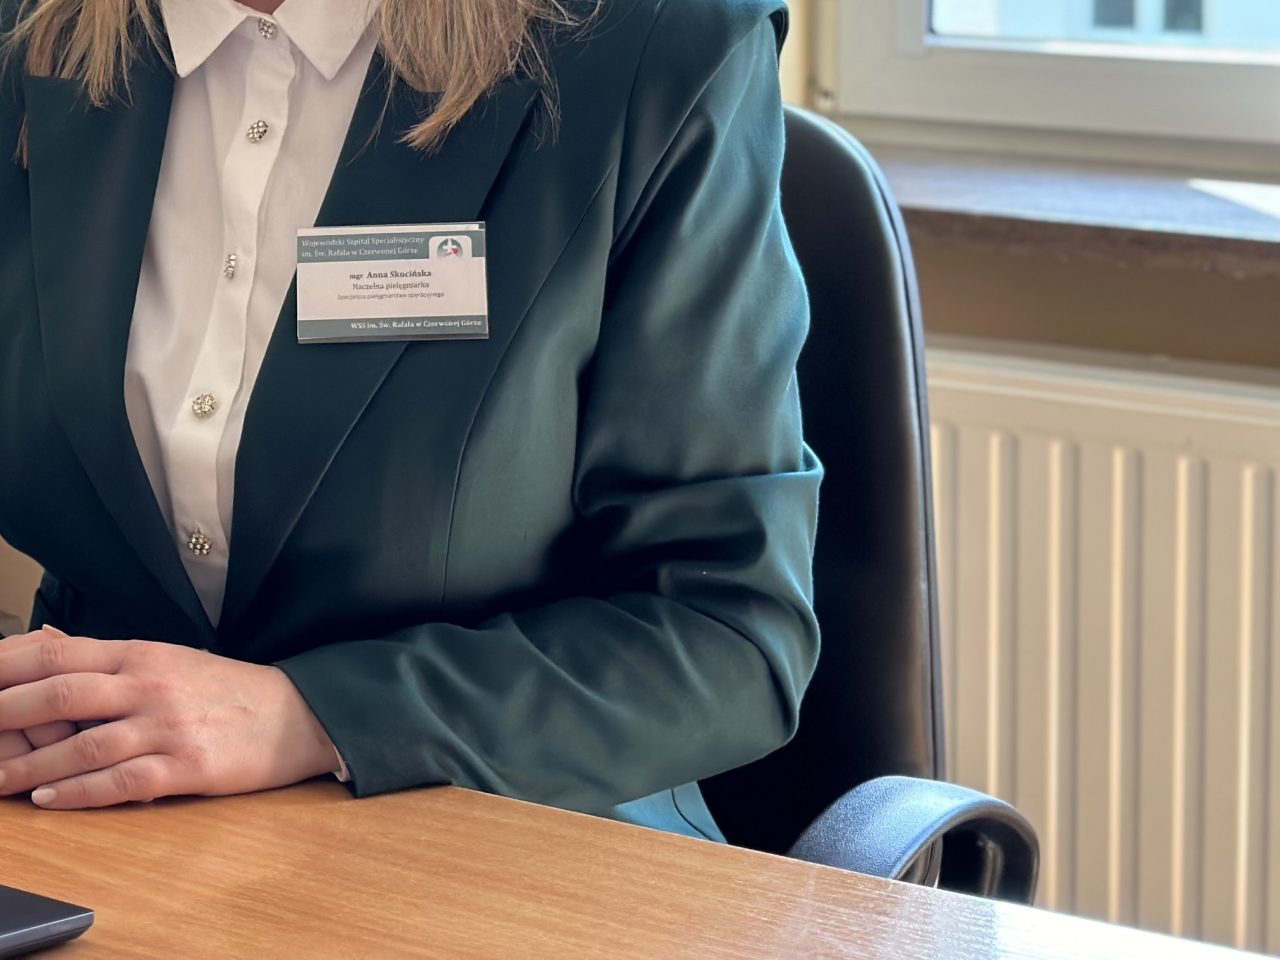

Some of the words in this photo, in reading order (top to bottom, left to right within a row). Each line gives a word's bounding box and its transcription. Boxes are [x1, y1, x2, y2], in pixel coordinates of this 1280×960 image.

[302, 238, 345, 248] Wojewódzki
[346, 237, 370, 246] Szpital
[371, 236, 425, 245] Specjalistyczny
[301, 250, 312, 258] im.
[359, 247, 396, 256] Czerwonej
[397, 246, 418, 255] Górze
[349, 272, 363, 280] mgr
[366, 271, 388, 279] Anna
[389, 269, 432, 279] Skucińska
[352, 282, 384, 291] Naczelna
[385, 281, 430, 290] pielęgniarka
[423, 319, 460, 328] Czerwonej
[460, 318, 483, 327] Górze
